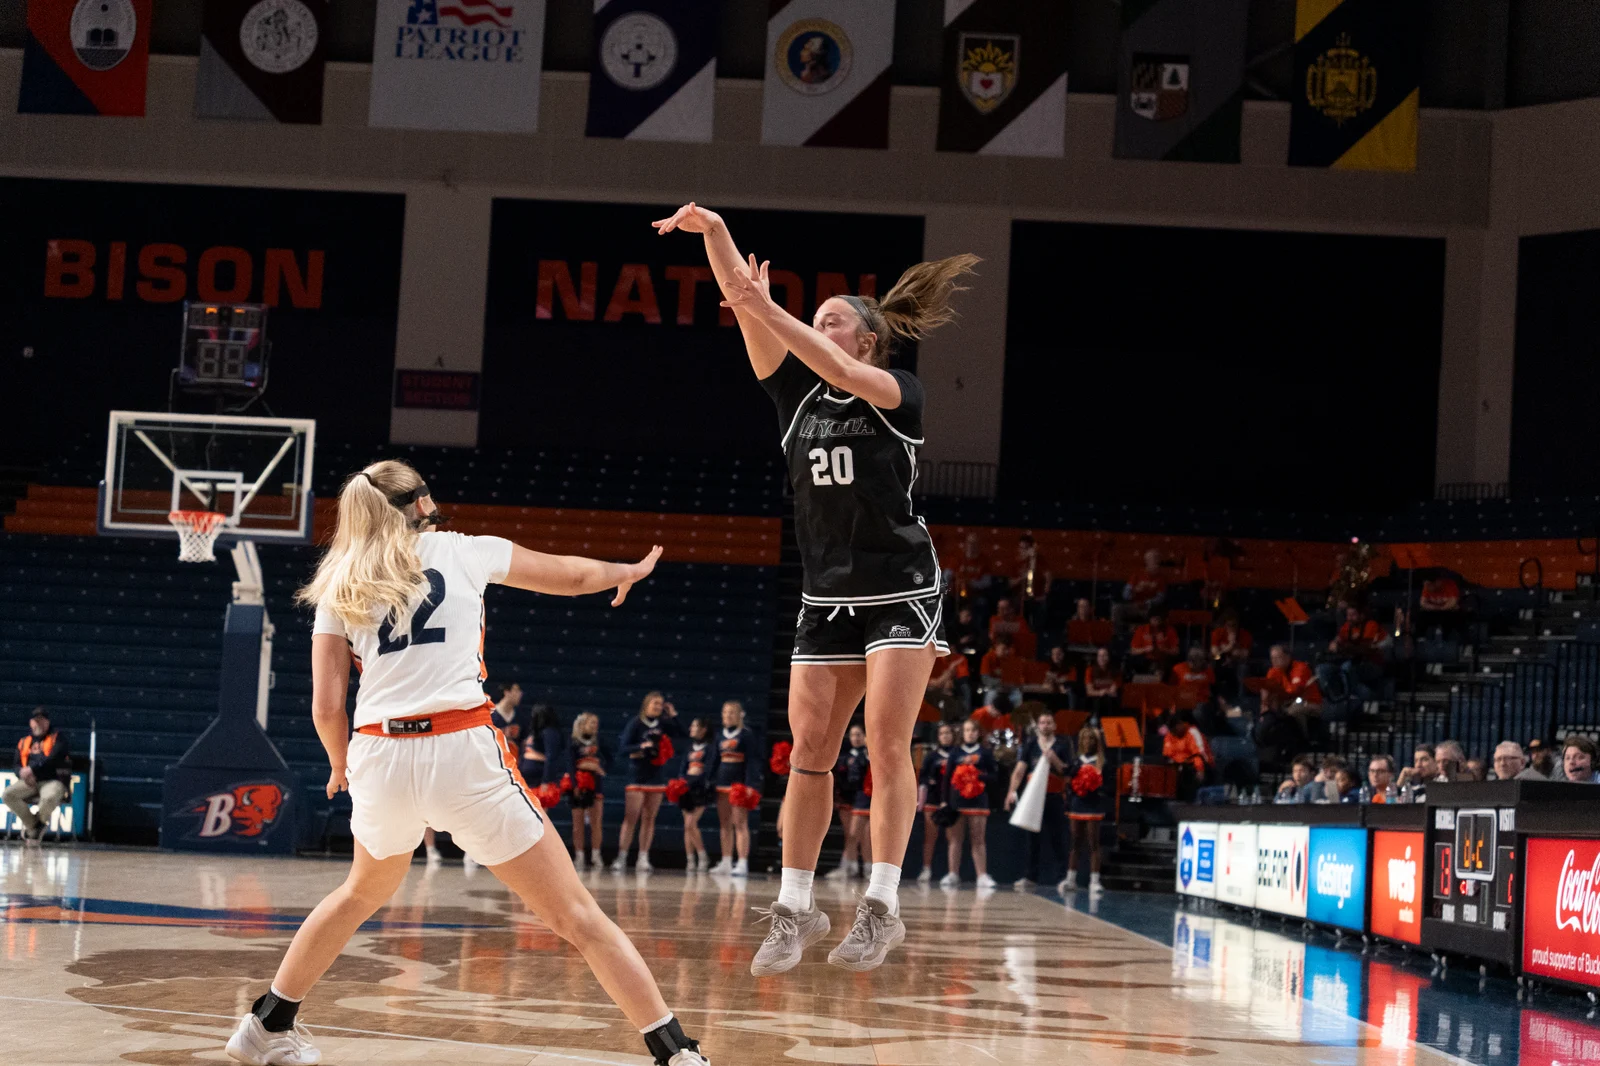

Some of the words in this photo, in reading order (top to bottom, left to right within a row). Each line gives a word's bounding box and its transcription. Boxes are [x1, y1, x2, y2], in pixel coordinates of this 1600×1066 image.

[397, 26, 526, 46] PATRIOT
[395, 43, 525, 62] LEAGUE
[44, 239, 326, 309] BISON
[808, 446, 855, 486] 20
[377, 568, 446, 657] 22
[1532, 947, 1549, 966] proud
[1549, 951, 1577, 971] supporter
[1578, 952, 1585, 971] of
